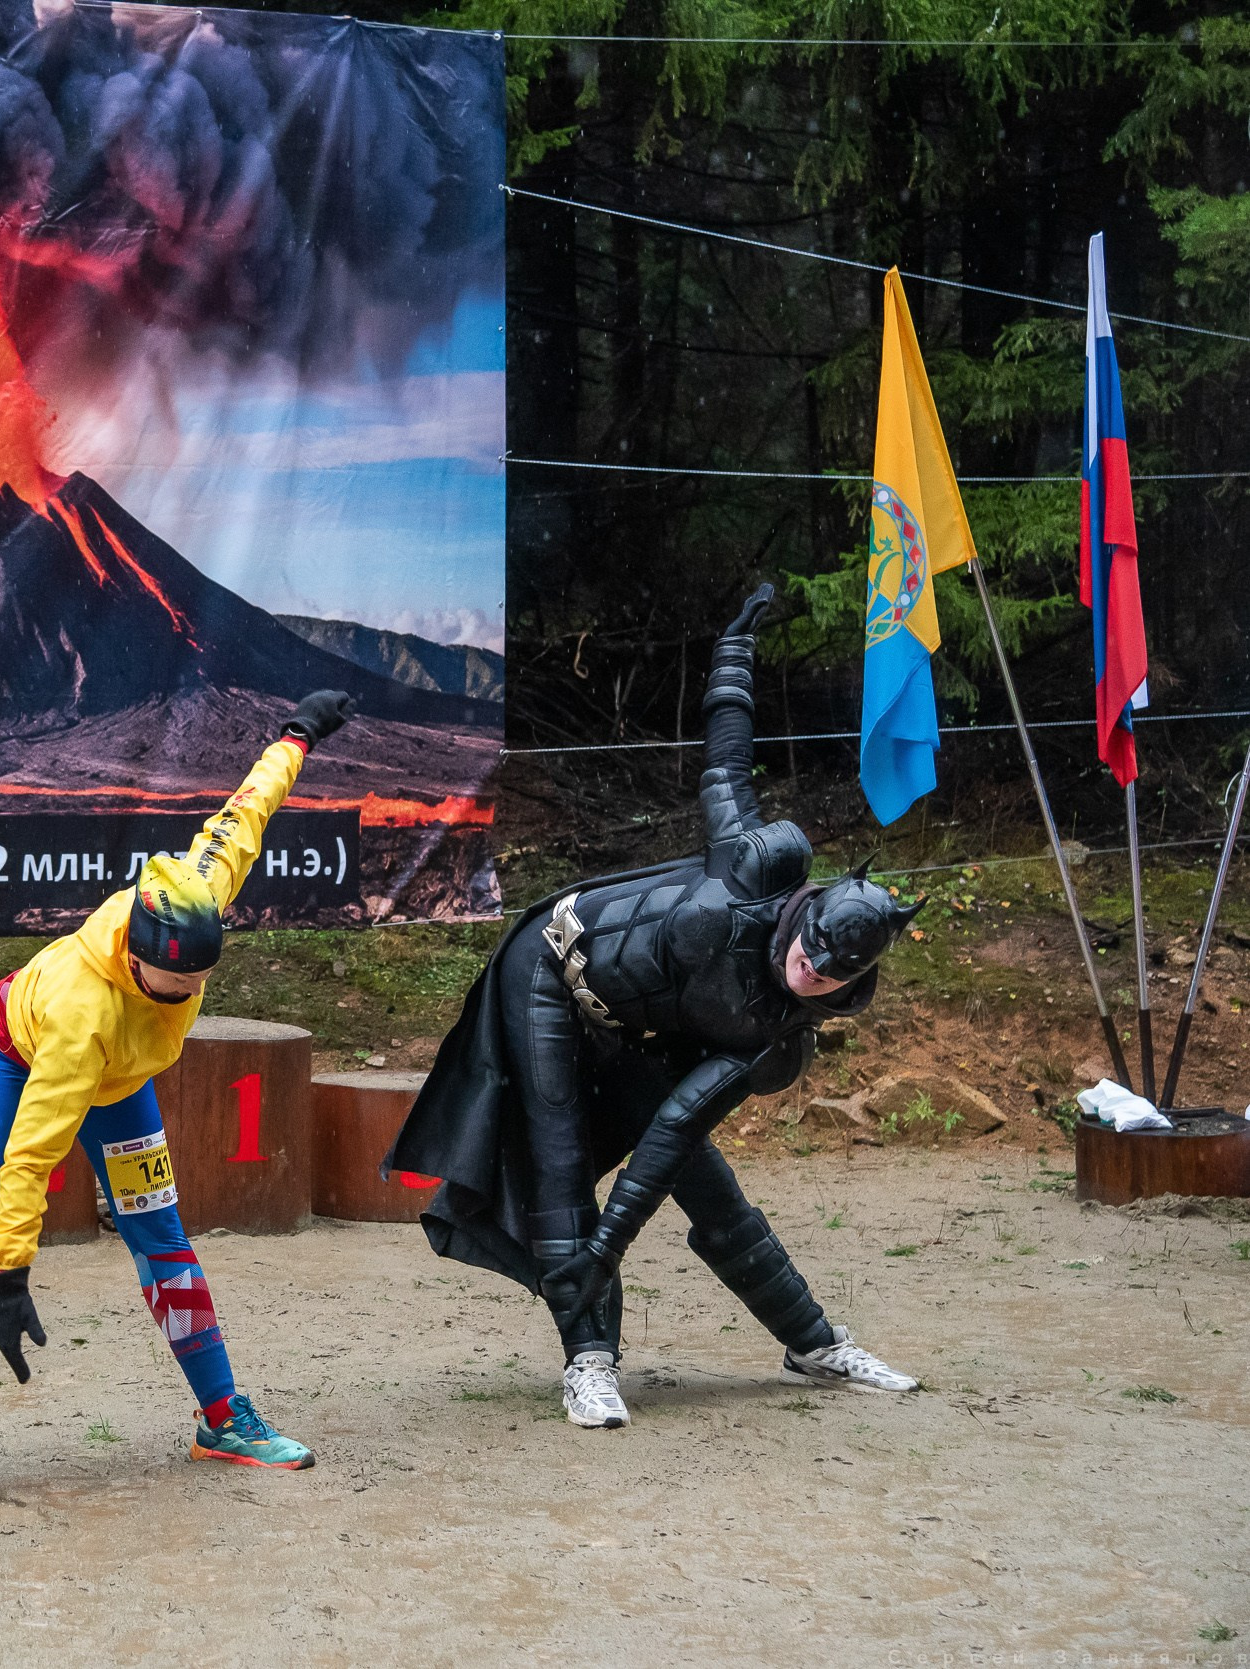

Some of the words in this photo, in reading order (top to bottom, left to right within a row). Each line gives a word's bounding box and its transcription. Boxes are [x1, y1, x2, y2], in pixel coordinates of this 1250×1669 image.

[22, 853, 113, 882] млн.
[266, 837, 347, 885] н.э.)
[226, 1073, 269, 1163] 1
[139, 1155, 171, 1184] 141
